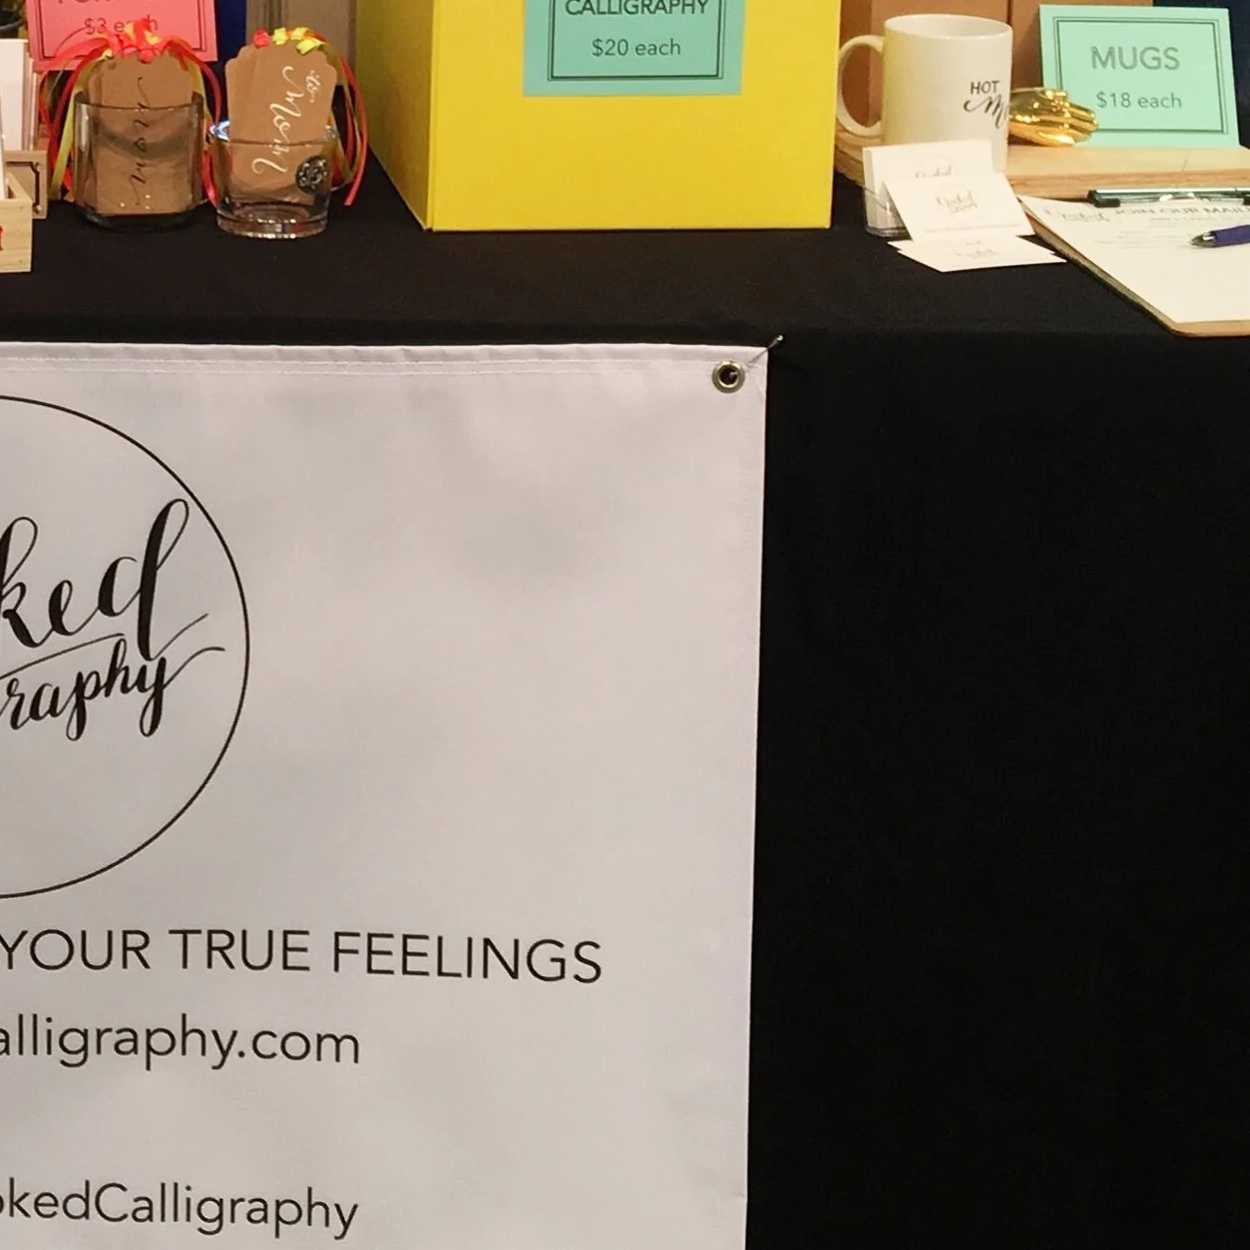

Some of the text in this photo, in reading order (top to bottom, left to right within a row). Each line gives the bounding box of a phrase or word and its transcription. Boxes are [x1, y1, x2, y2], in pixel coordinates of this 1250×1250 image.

[591, 37, 681, 58] $20 each
[1091, 46, 1180, 70] MUGS
[970, 80, 1000, 95] HOT
[1096, 91, 1182, 110] $18 each
[169, 930, 310, 971] TRUE
[334, 932, 601, 983] FEELINGS
